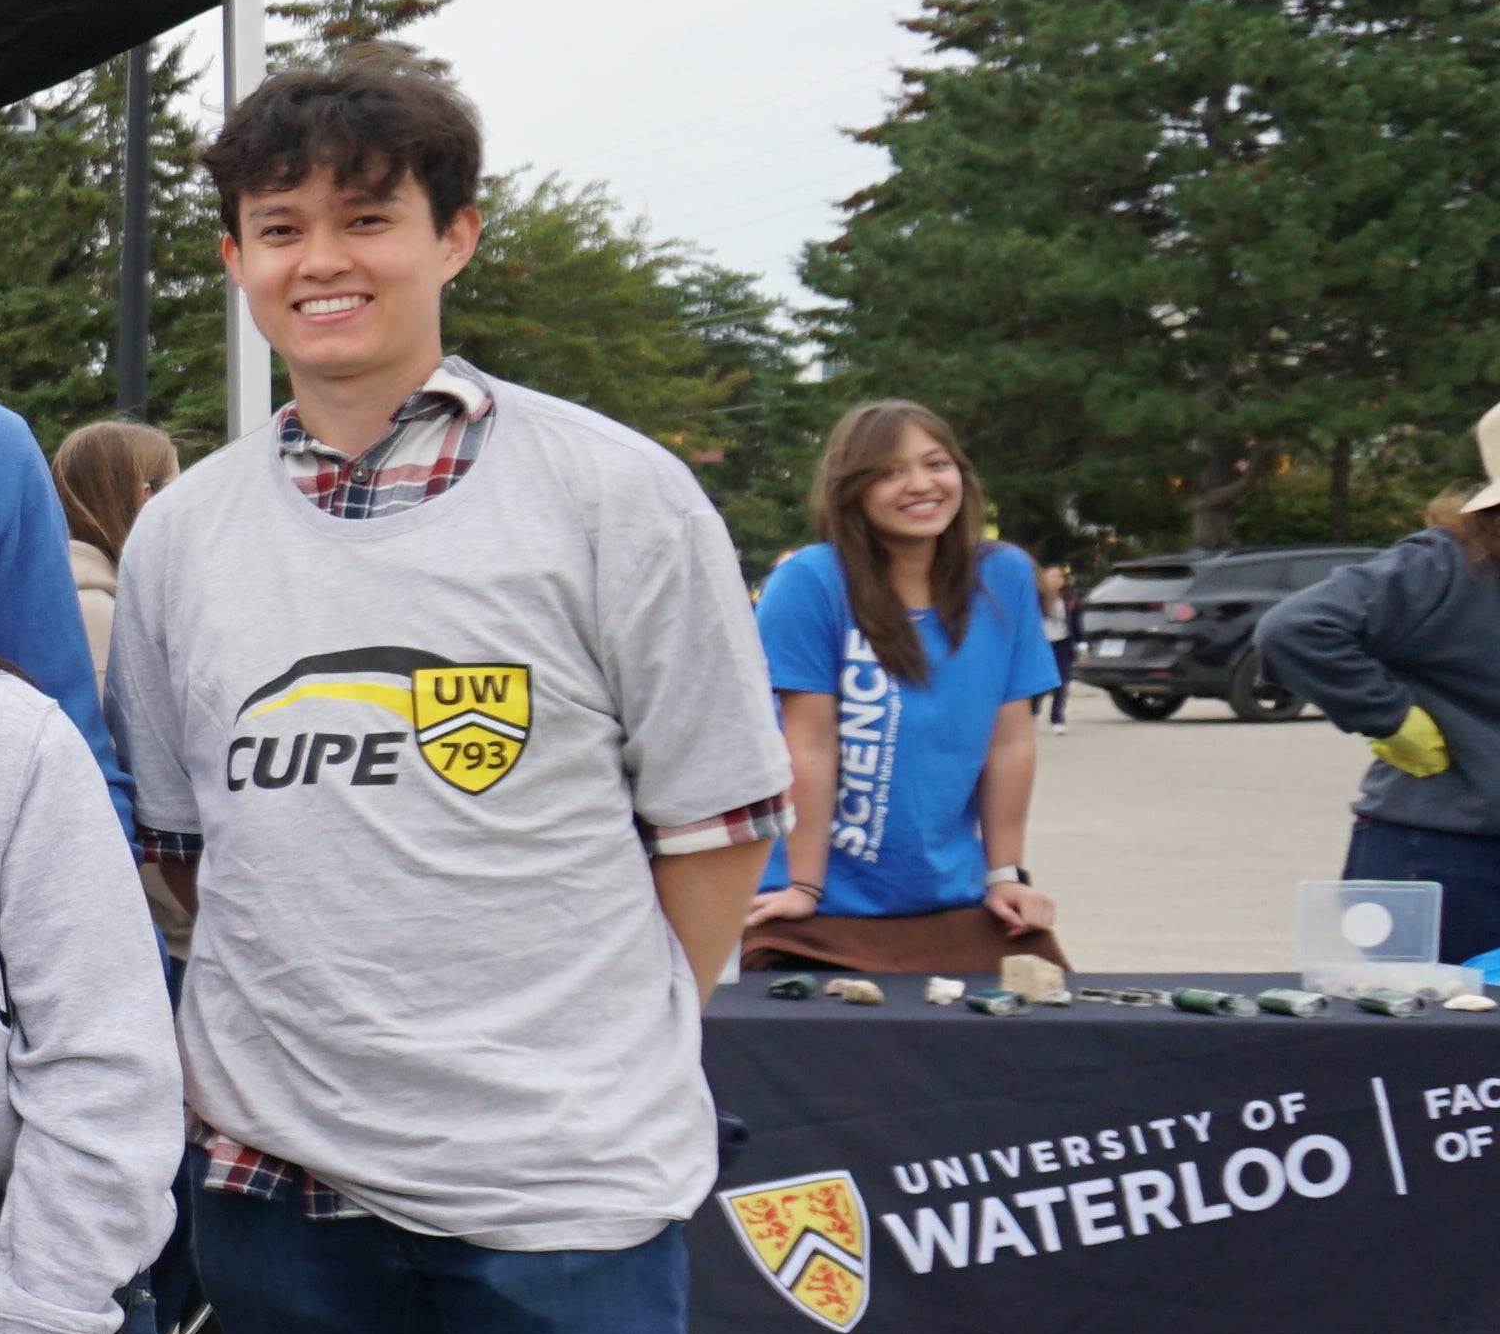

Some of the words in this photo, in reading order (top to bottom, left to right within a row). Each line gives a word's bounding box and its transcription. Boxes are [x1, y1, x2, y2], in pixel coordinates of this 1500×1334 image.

[434, 674, 511, 706] UW
[227, 731, 409, 792] CUPE
[440, 741, 509, 772] 793
[893, 1110, 1213, 1195] UNIVERSITY
[1241, 1092, 1308, 1132] OF
[1433, 1124, 1497, 1164] OF
[881, 1133, 1352, 1275] WATERLOO
